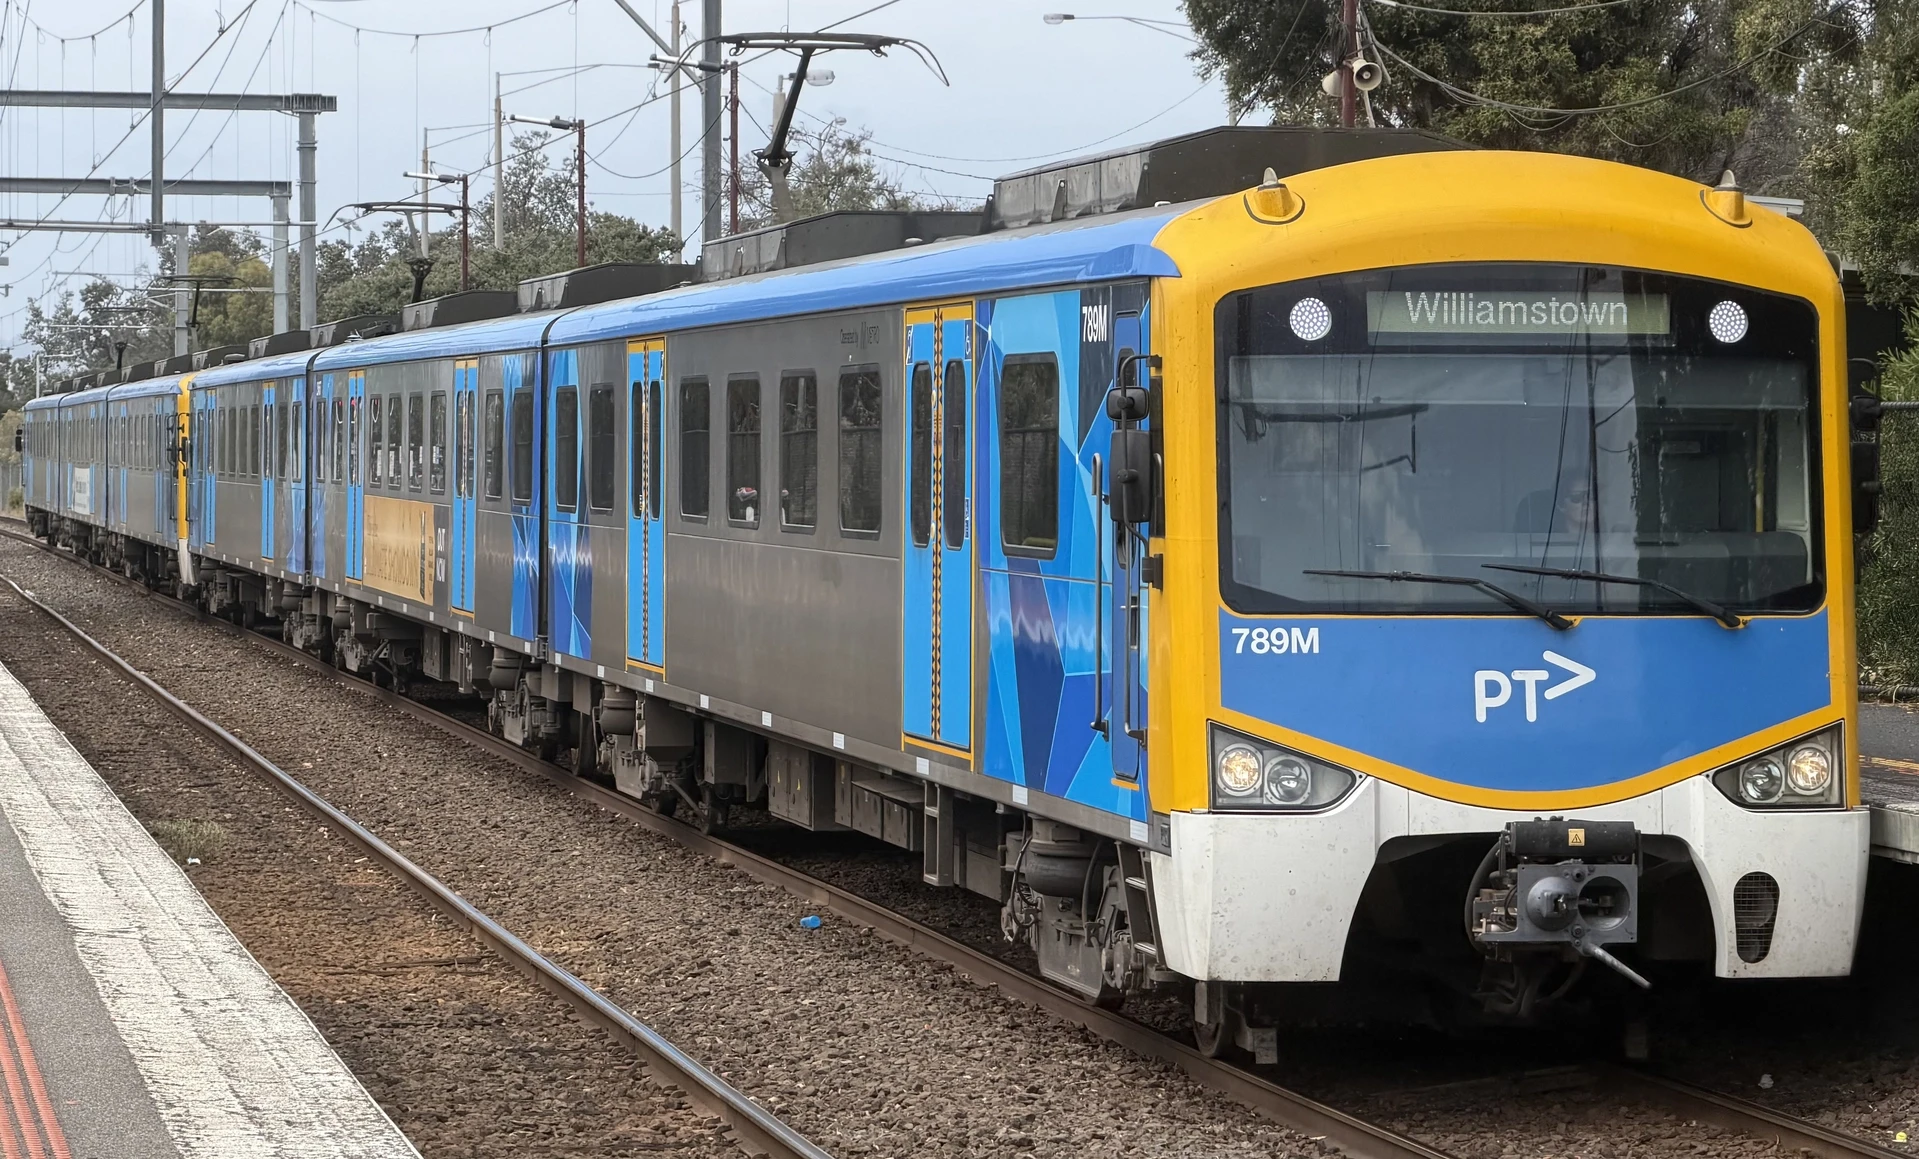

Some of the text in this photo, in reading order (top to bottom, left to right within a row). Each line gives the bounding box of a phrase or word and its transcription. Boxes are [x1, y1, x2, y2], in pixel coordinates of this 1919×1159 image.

[1082, 304, 1107, 343] 789M
[1405, 291, 1629, 326] Williamstown
[1231, 627, 1320, 655] 789M
